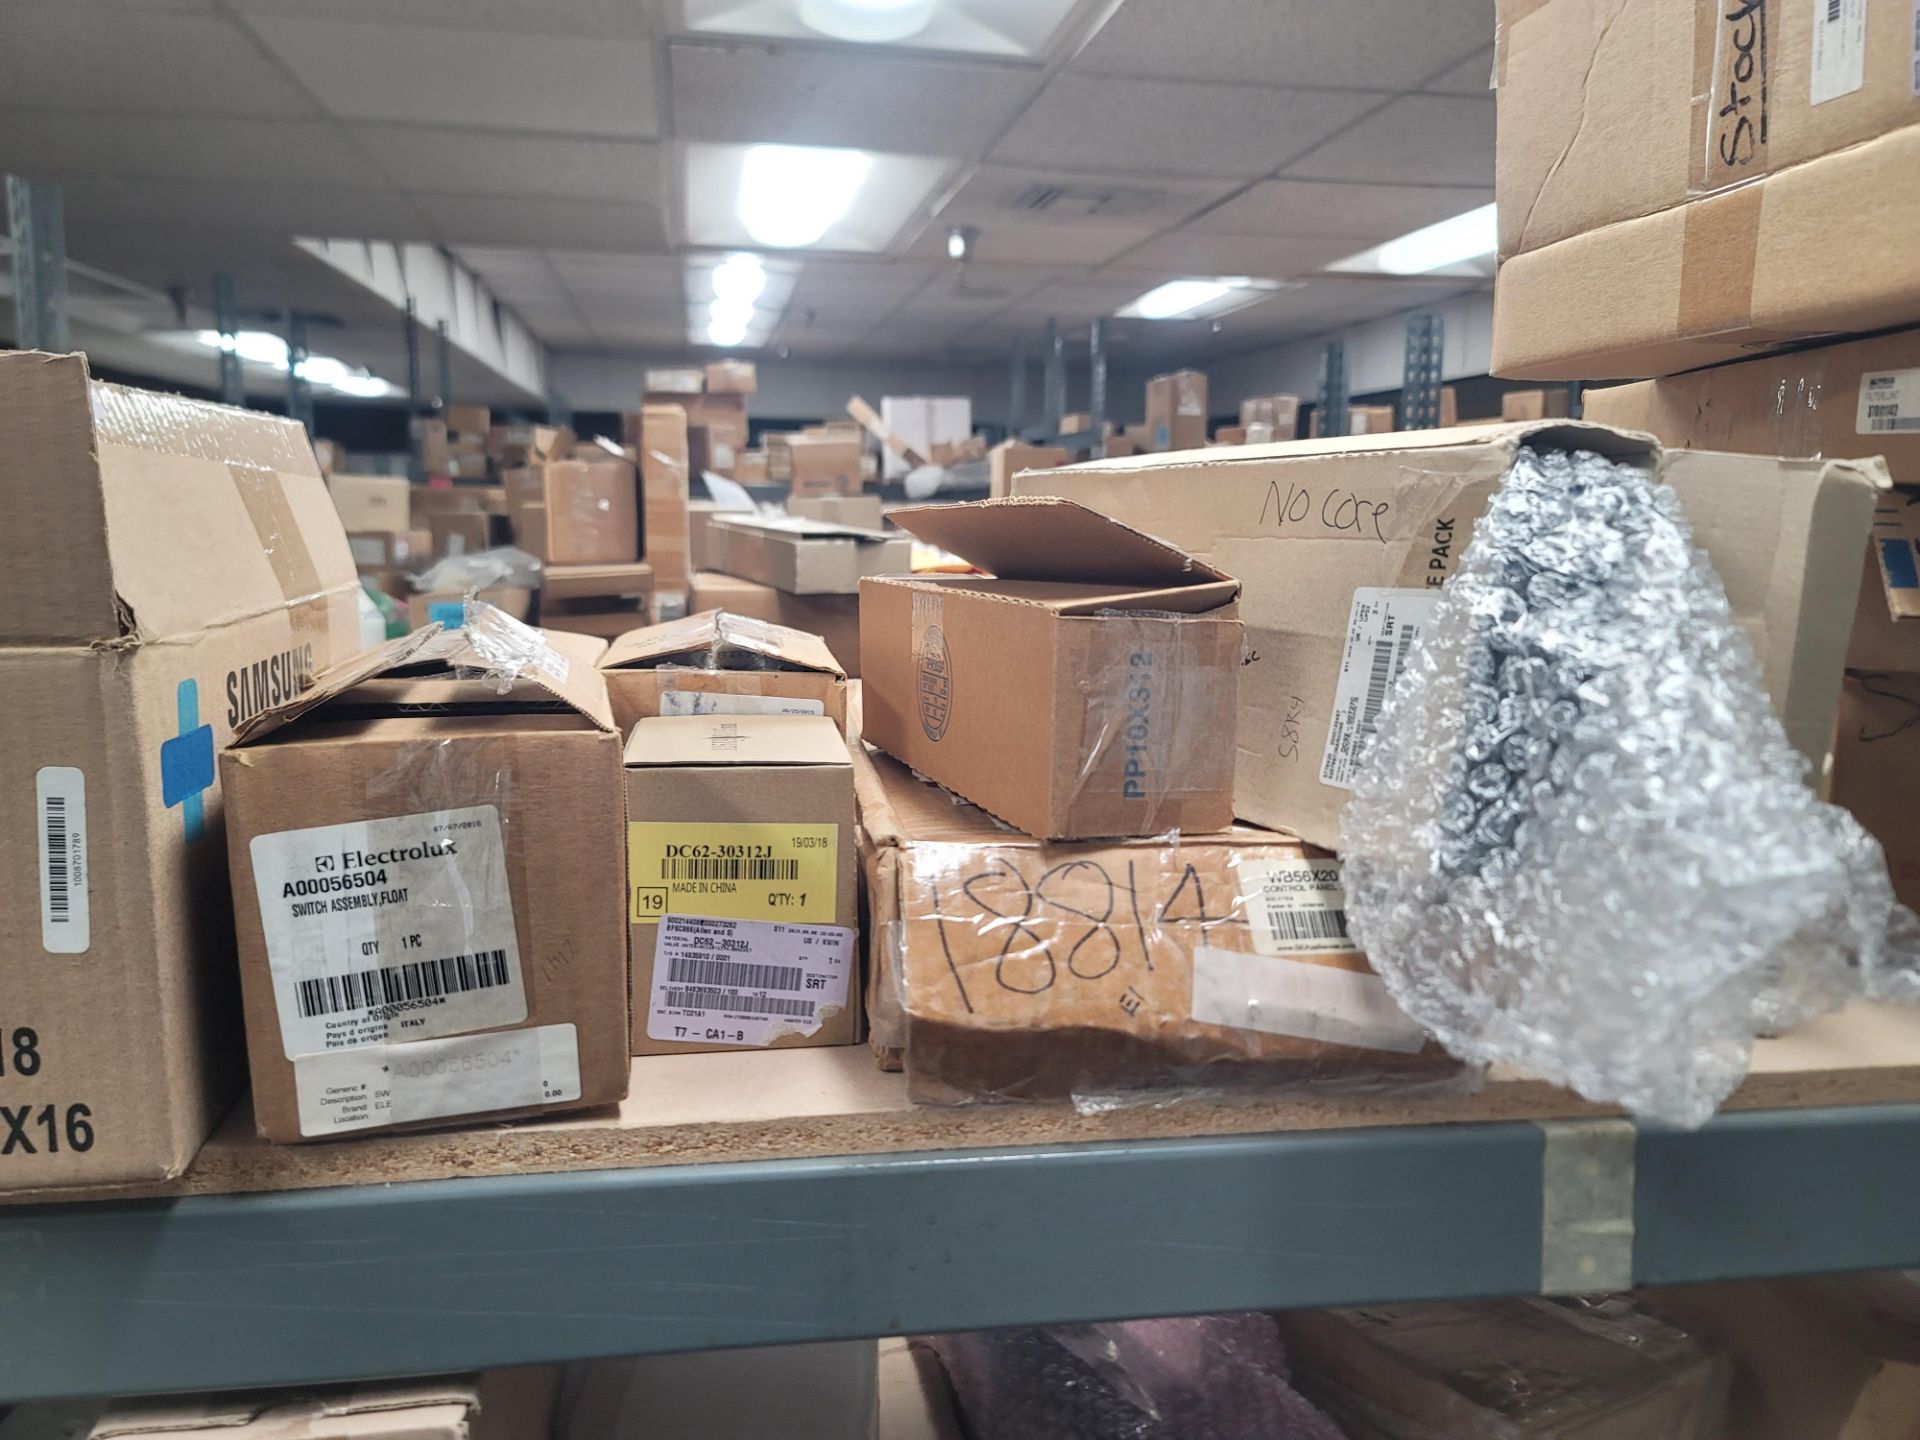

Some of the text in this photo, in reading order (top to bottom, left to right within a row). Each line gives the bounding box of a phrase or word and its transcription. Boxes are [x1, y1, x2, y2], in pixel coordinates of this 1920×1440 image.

[1428, 518, 1456, 570] PACK
[1385, 614, 1396, 636] SRT
[791, 836, 828, 849] 19/03/18
[342, 840, 459, 870] Electrolux
[665, 844, 772, 859] DC62-30312J
[283, 869, 388, 899] A00056504
[672, 882, 737, 894] MADE IN CHINA
[1262, 884, 1307, 893] CONTROL
[292, 888, 409, 918] SWITCH ASSEMBLY,FLOAT
[642, 895, 663, 909] 19
[799, 893, 807, 906] 1
[361, 933, 423, 957] QTY 1 PC
[806, 978, 828, 990] SRT
[325, 1016, 359, 1030] Country
[361, 1015, 371, 1023] of
[401, 1018, 426, 1029] ITALY
[326, 1030, 347, 1040] Pays
[357, 1023, 389, 1035] origine
[674, 1025, 688, 1037] T7
[347, 1037, 358, 1045] de
[360, 1031, 389, 1044] origen
[326, 1085, 359, 1095] Generic
[542, 1079, 549, 1088] 0
[320, 1093, 368, 1106] Description
[544, 1088, 563, 1098] 0.00
[342, 1103, 368, 1114] Brand
[333, 1113, 369, 1124] Location
[0, 1103, 95, 1156] X16
